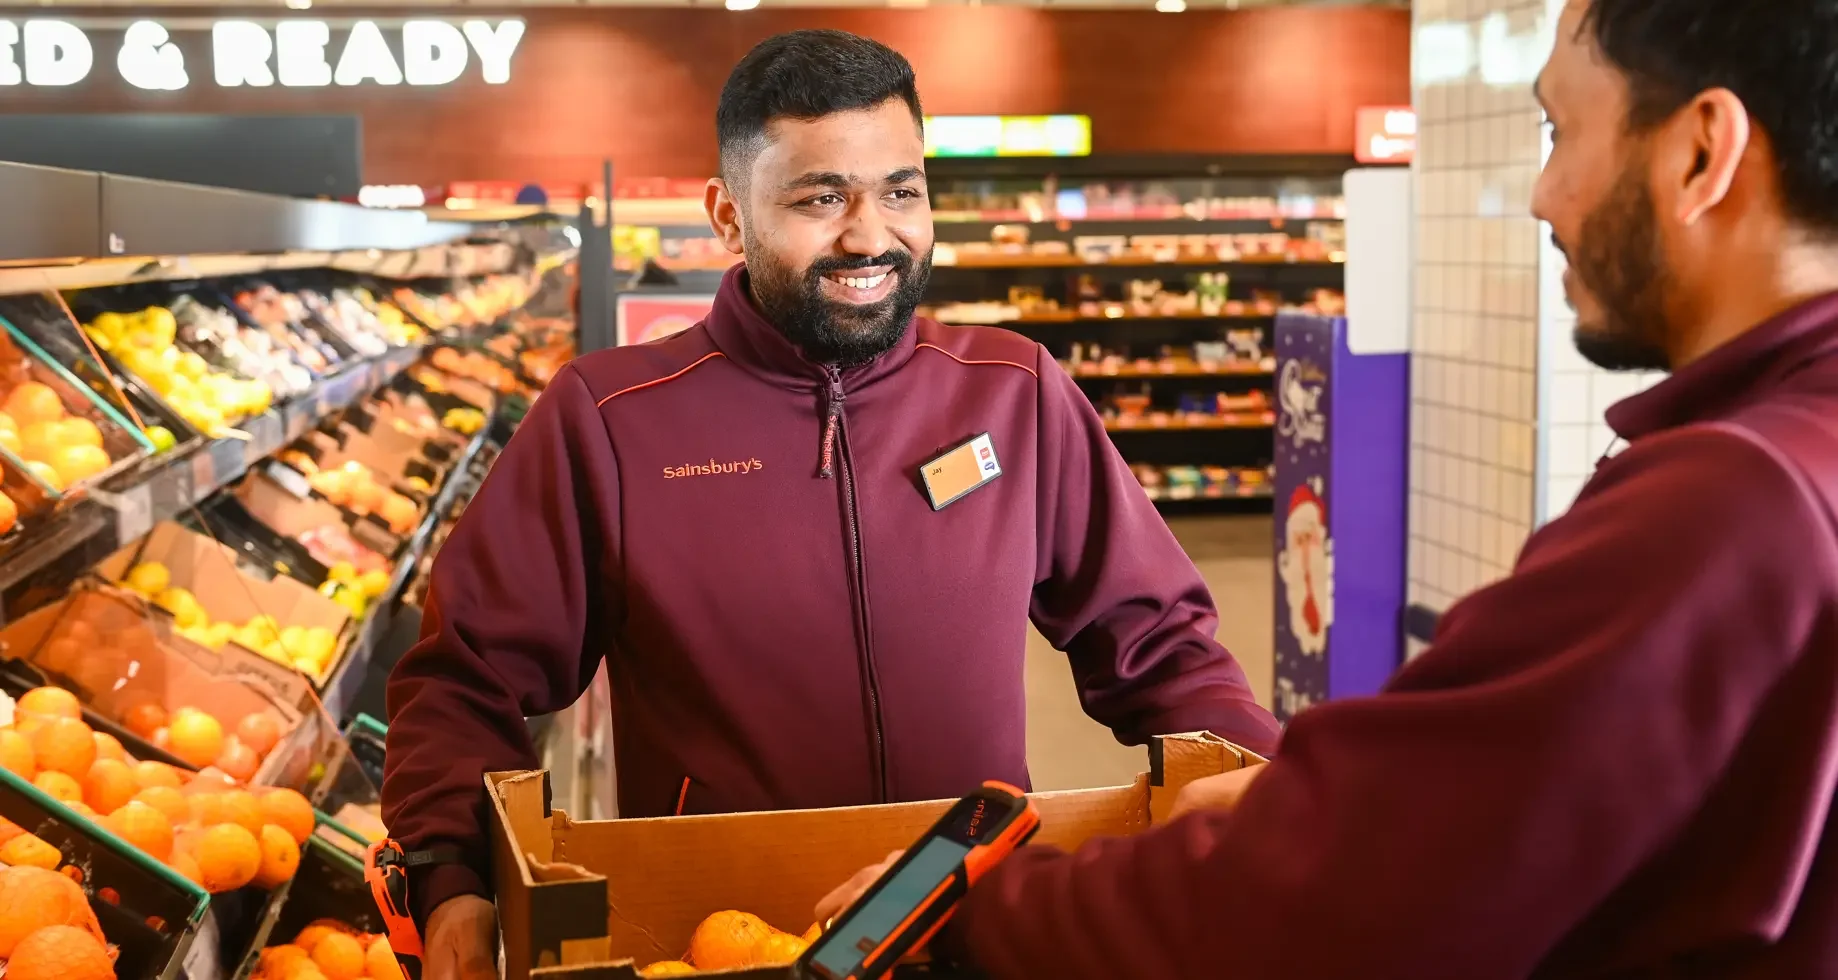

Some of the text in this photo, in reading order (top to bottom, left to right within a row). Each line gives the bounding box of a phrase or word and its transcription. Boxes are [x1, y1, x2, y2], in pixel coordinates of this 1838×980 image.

[117, 20, 189, 91] &
[212, 20, 526, 87] READY
[663, 457, 763, 479] Sainsbury's
[932, 467, 942, 476] Jay
